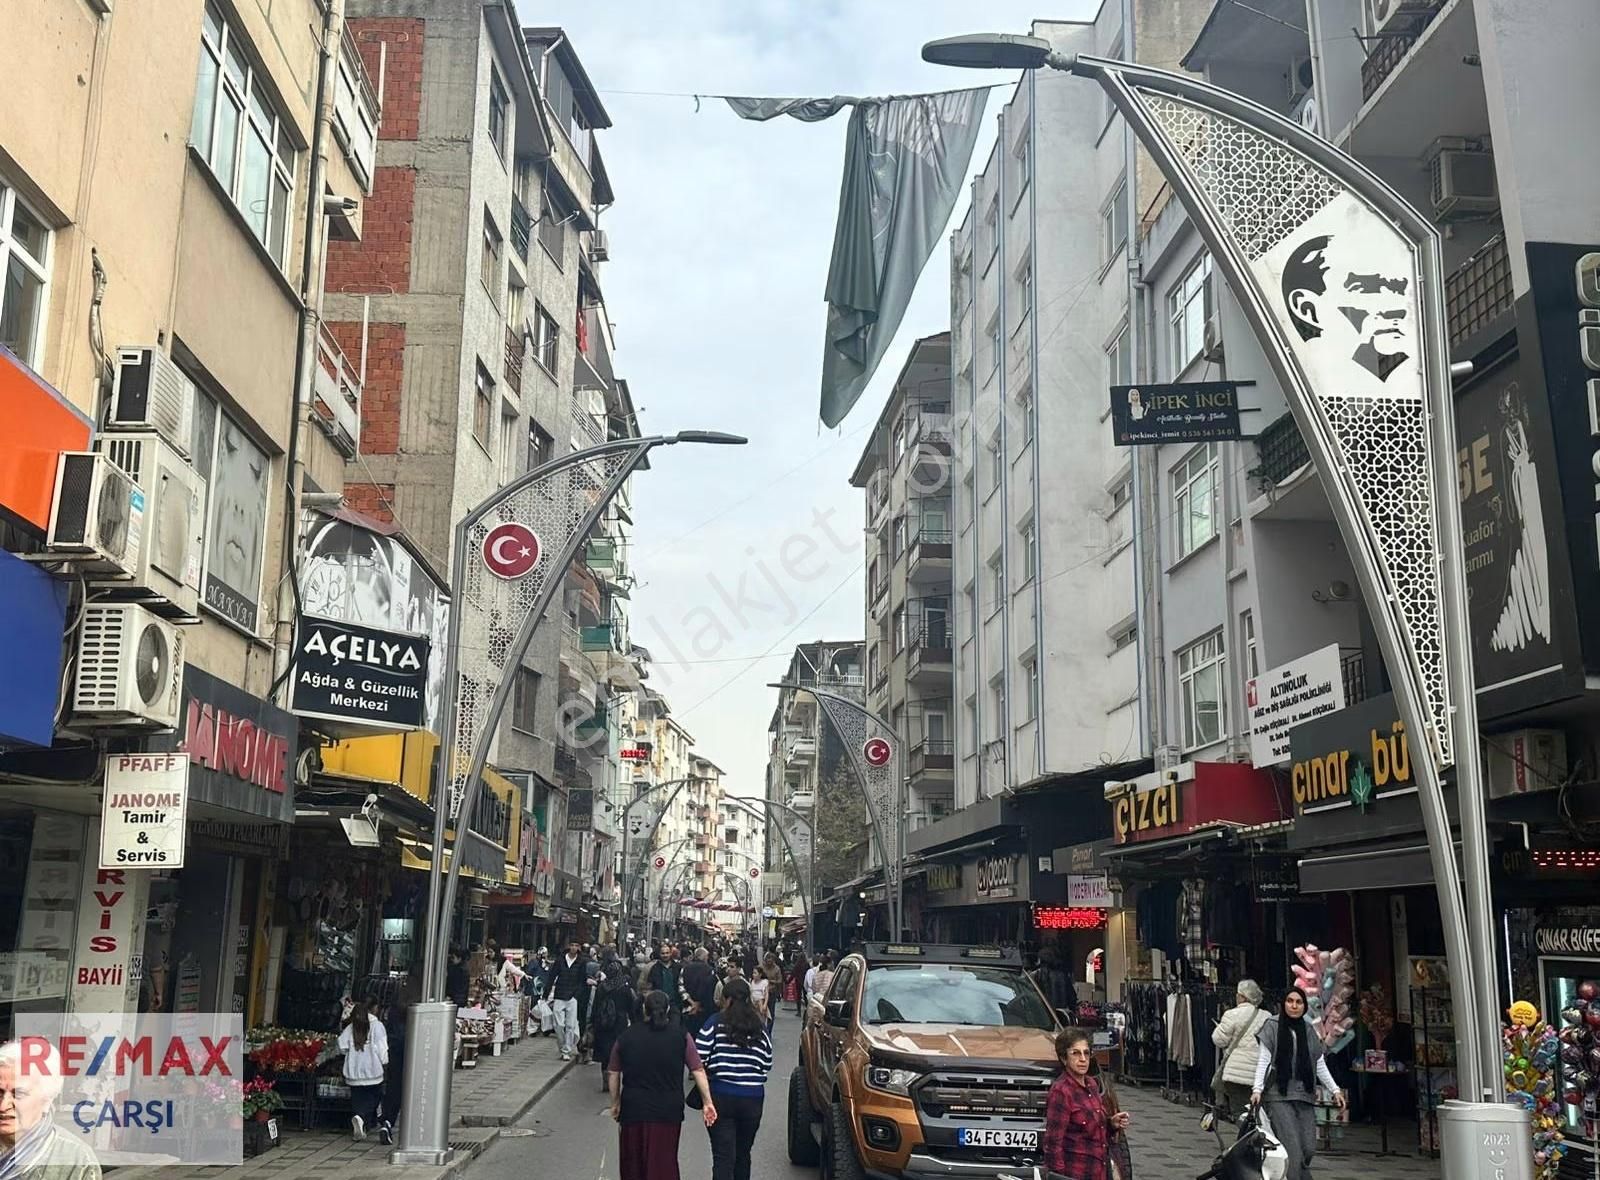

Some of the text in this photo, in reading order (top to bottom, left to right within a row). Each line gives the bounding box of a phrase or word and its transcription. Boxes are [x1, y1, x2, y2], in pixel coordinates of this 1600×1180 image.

[1150, 390, 1233, 410] İPEK İNCİ
[304, 629, 421, 670] AÇELYA
[300, 670, 419, 699] Ağda & Güzellik
[1270, 674, 1308, 698] ALTINOLUK
[330, 693, 388, 712] Merkezi
[178, 698, 289, 794] JANOME
[119, 758, 176, 772] PFAFF
[1292, 720, 1410, 815] çınar bü
[110, 793, 180, 808] JANOME
[1116, 773, 1177, 844] ÇİZGİ
[122, 810, 166, 824] Tamir
[137, 832, 148, 844] &
[116, 848, 166, 862] Servis
[90, 869, 126, 953] RVİS
[1536, 928, 1571, 954] ÇINAR
[78, 964, 123, 986] BAYİİ
[966, 1130, 1036, 1147] 34 FC 3442
[1483, 1133, 1511, 1146] 2023
